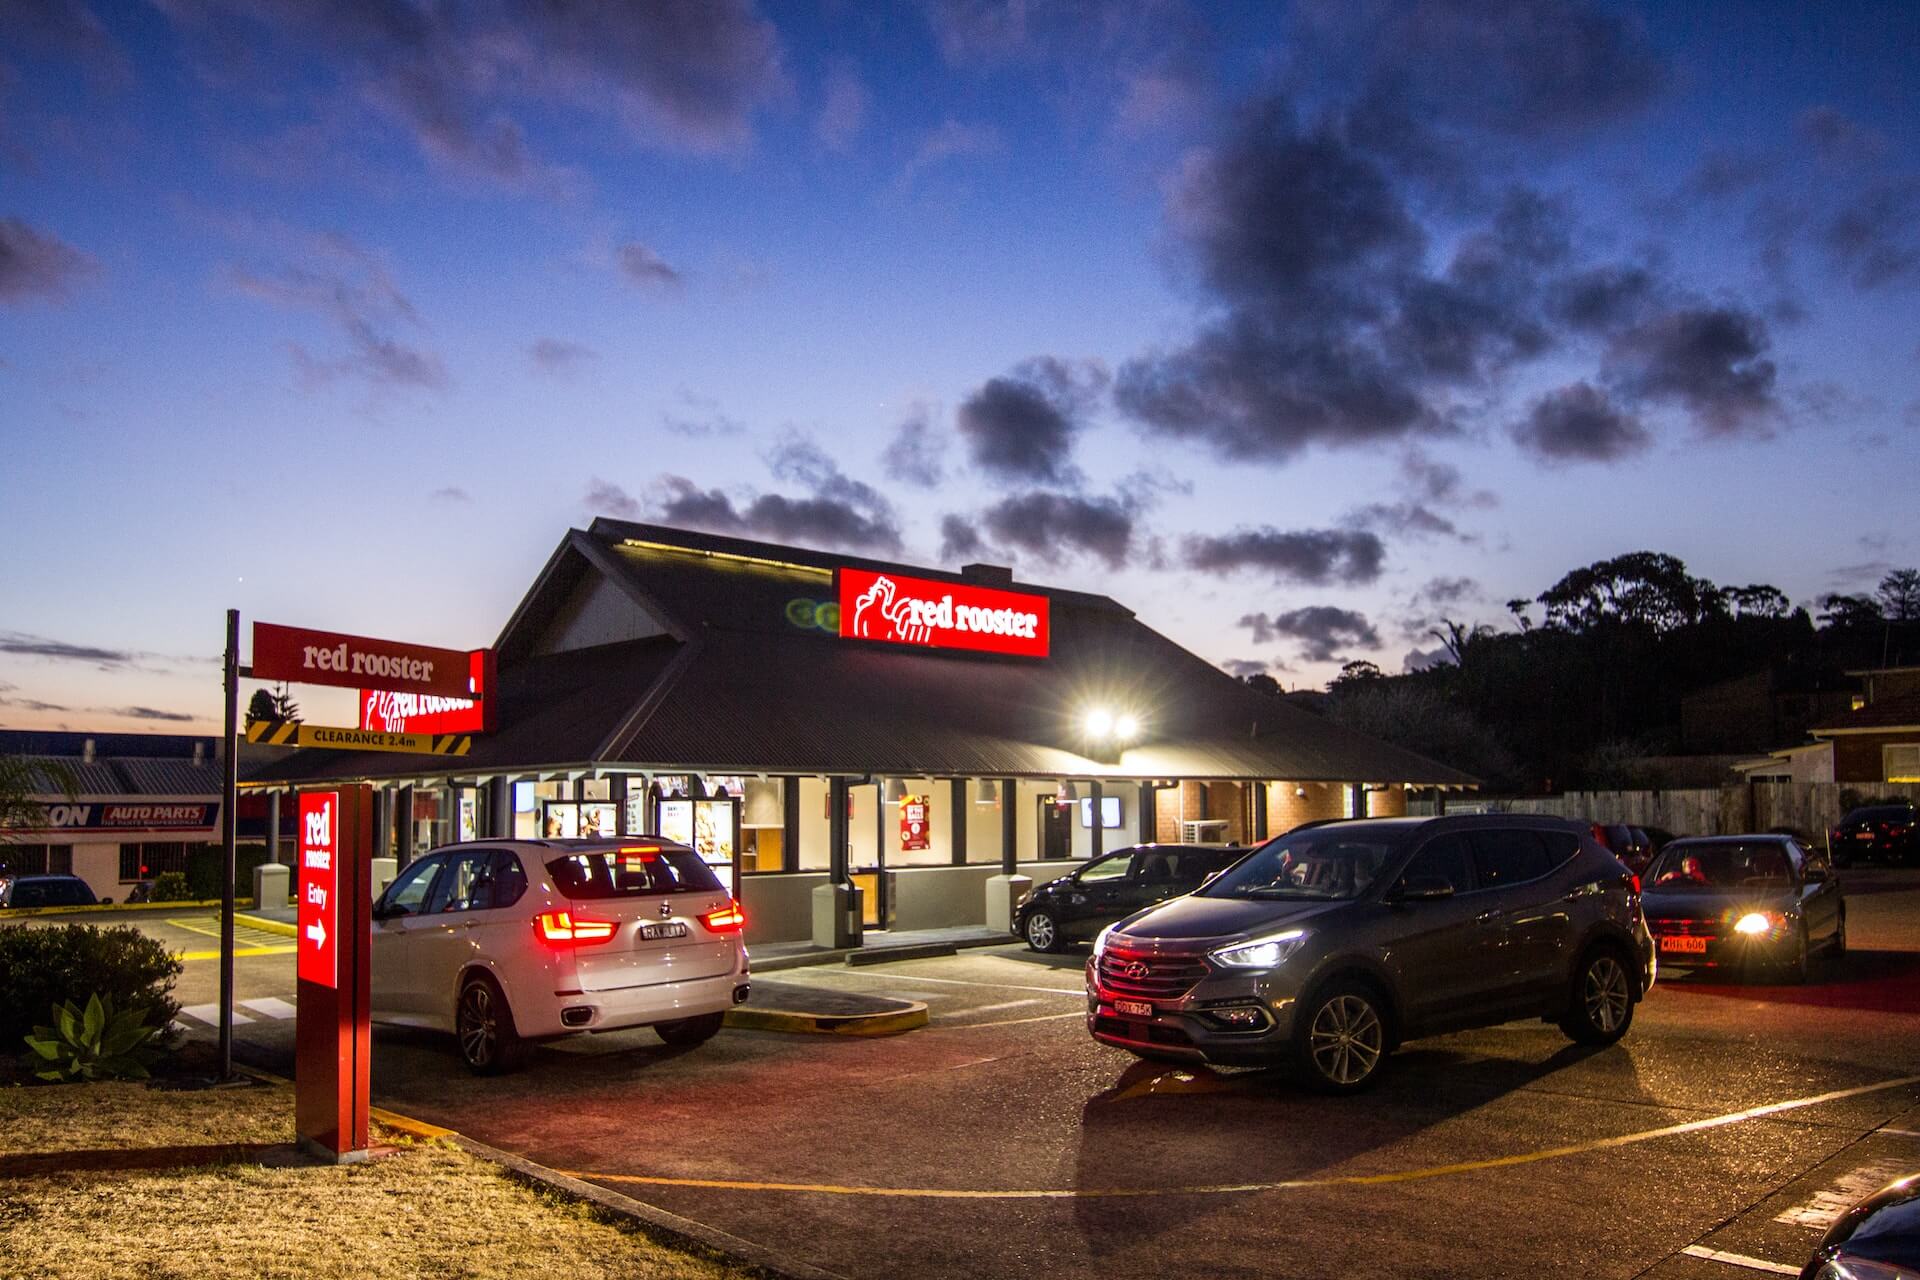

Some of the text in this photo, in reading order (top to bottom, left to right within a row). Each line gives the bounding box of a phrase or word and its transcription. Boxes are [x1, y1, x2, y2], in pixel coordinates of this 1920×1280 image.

[908, 595, 1038, 639] red rooster
[303, 643, 433, 682] red rooster
[314, 730, 416, 747] CLEARANCE 2.4m
[109, 806, 200, 819] AUTO PARTS
[305, 800, 331, 846] red
[305, 849, 331, 870] rooster
[307, 882, 328, 911] Entry
